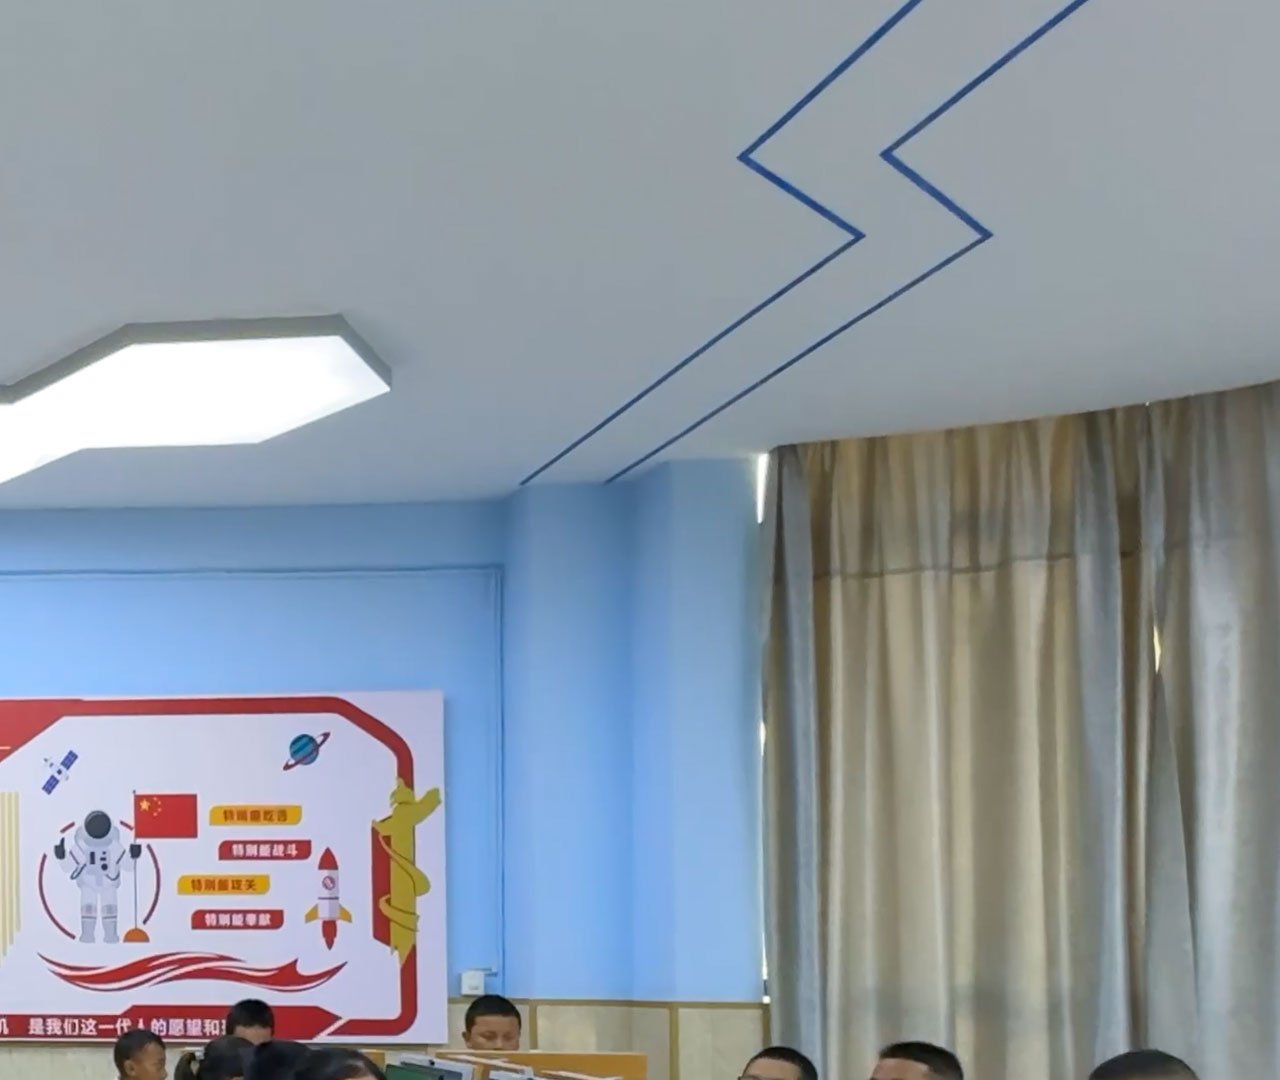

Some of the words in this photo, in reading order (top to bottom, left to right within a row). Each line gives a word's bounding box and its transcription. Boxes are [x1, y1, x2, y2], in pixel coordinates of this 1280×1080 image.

[231, 843, 298, 858] 特别能战斗
